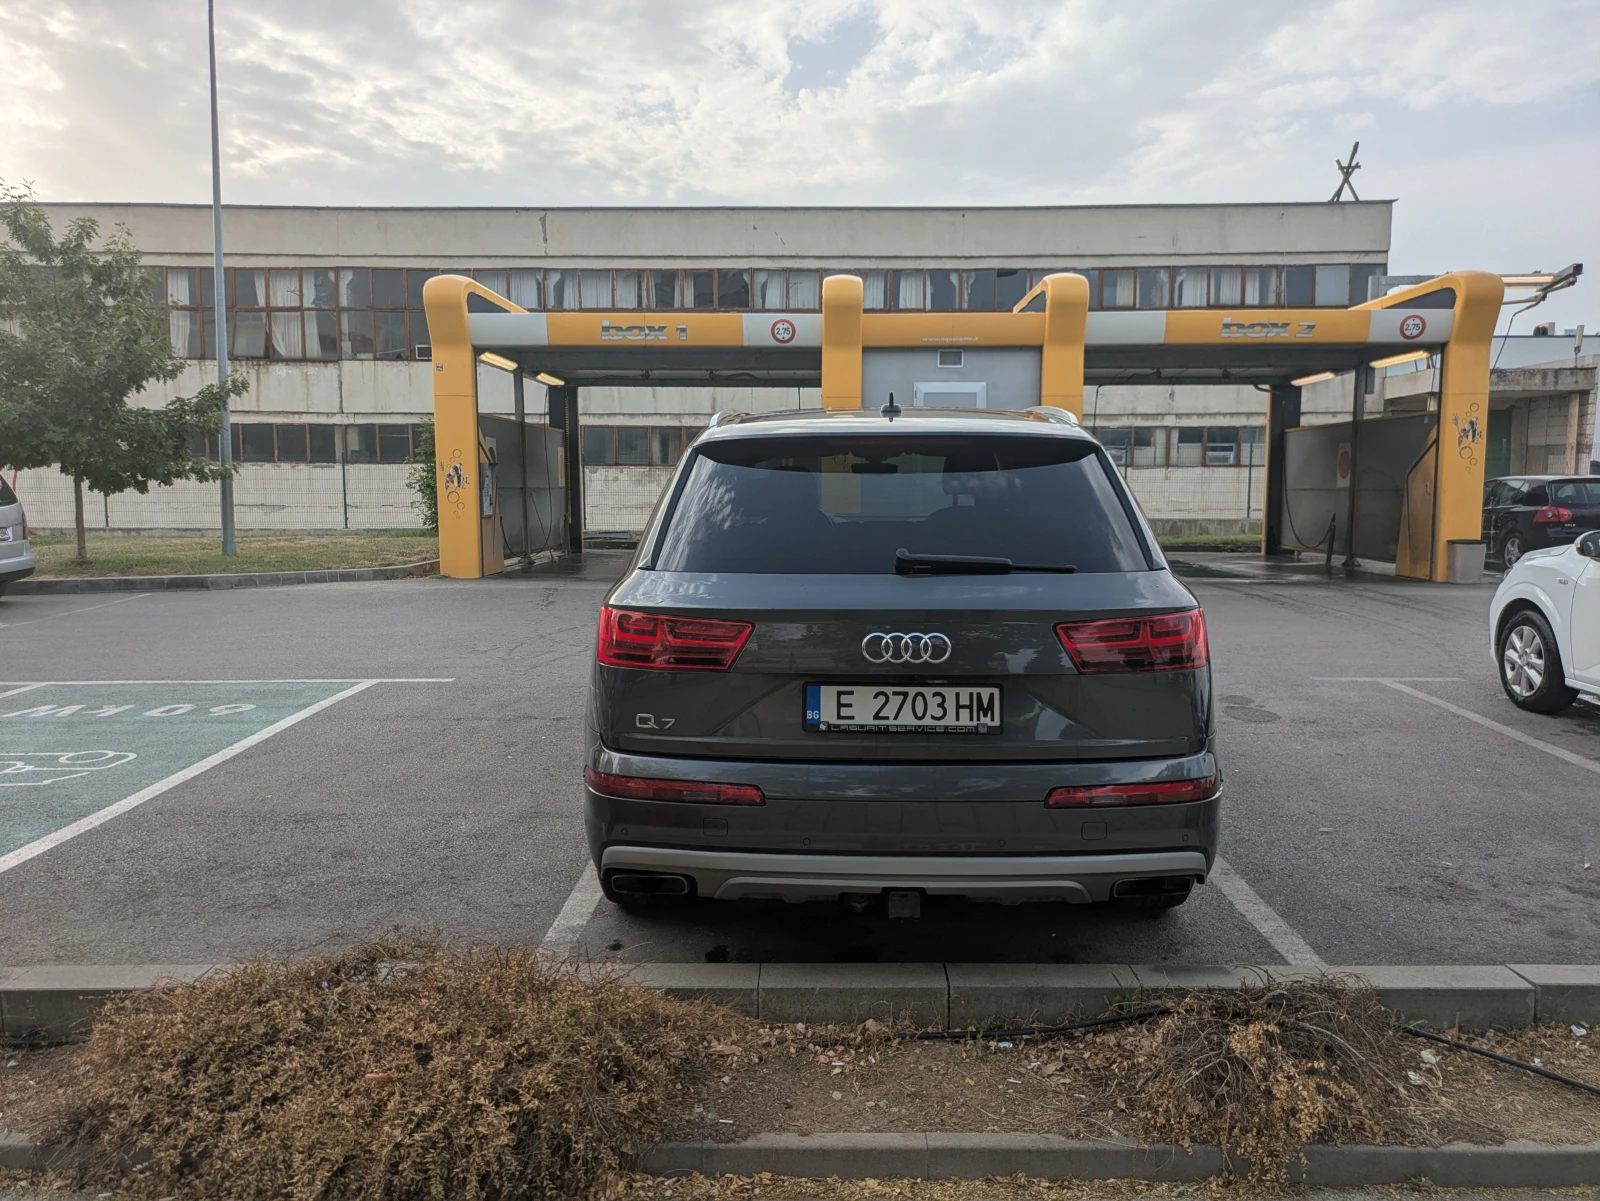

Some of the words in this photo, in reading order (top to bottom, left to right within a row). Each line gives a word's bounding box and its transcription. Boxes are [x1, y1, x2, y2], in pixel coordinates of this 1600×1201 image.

[601, 320, 668, 340] box
[675, 325, 688, 340] 1
[775, 326, 791, 337] 2.75
[1221, 317, 1291, 337] box
[1404, 323, 1421, 333] 2.75
[836, 690, 855, 720] E
[872, 691, 948, 721] 2703
[955, 692, 995, 722] HM
[635, 713, 676, 729] Q7
[806, 710, 819, 719] BG
